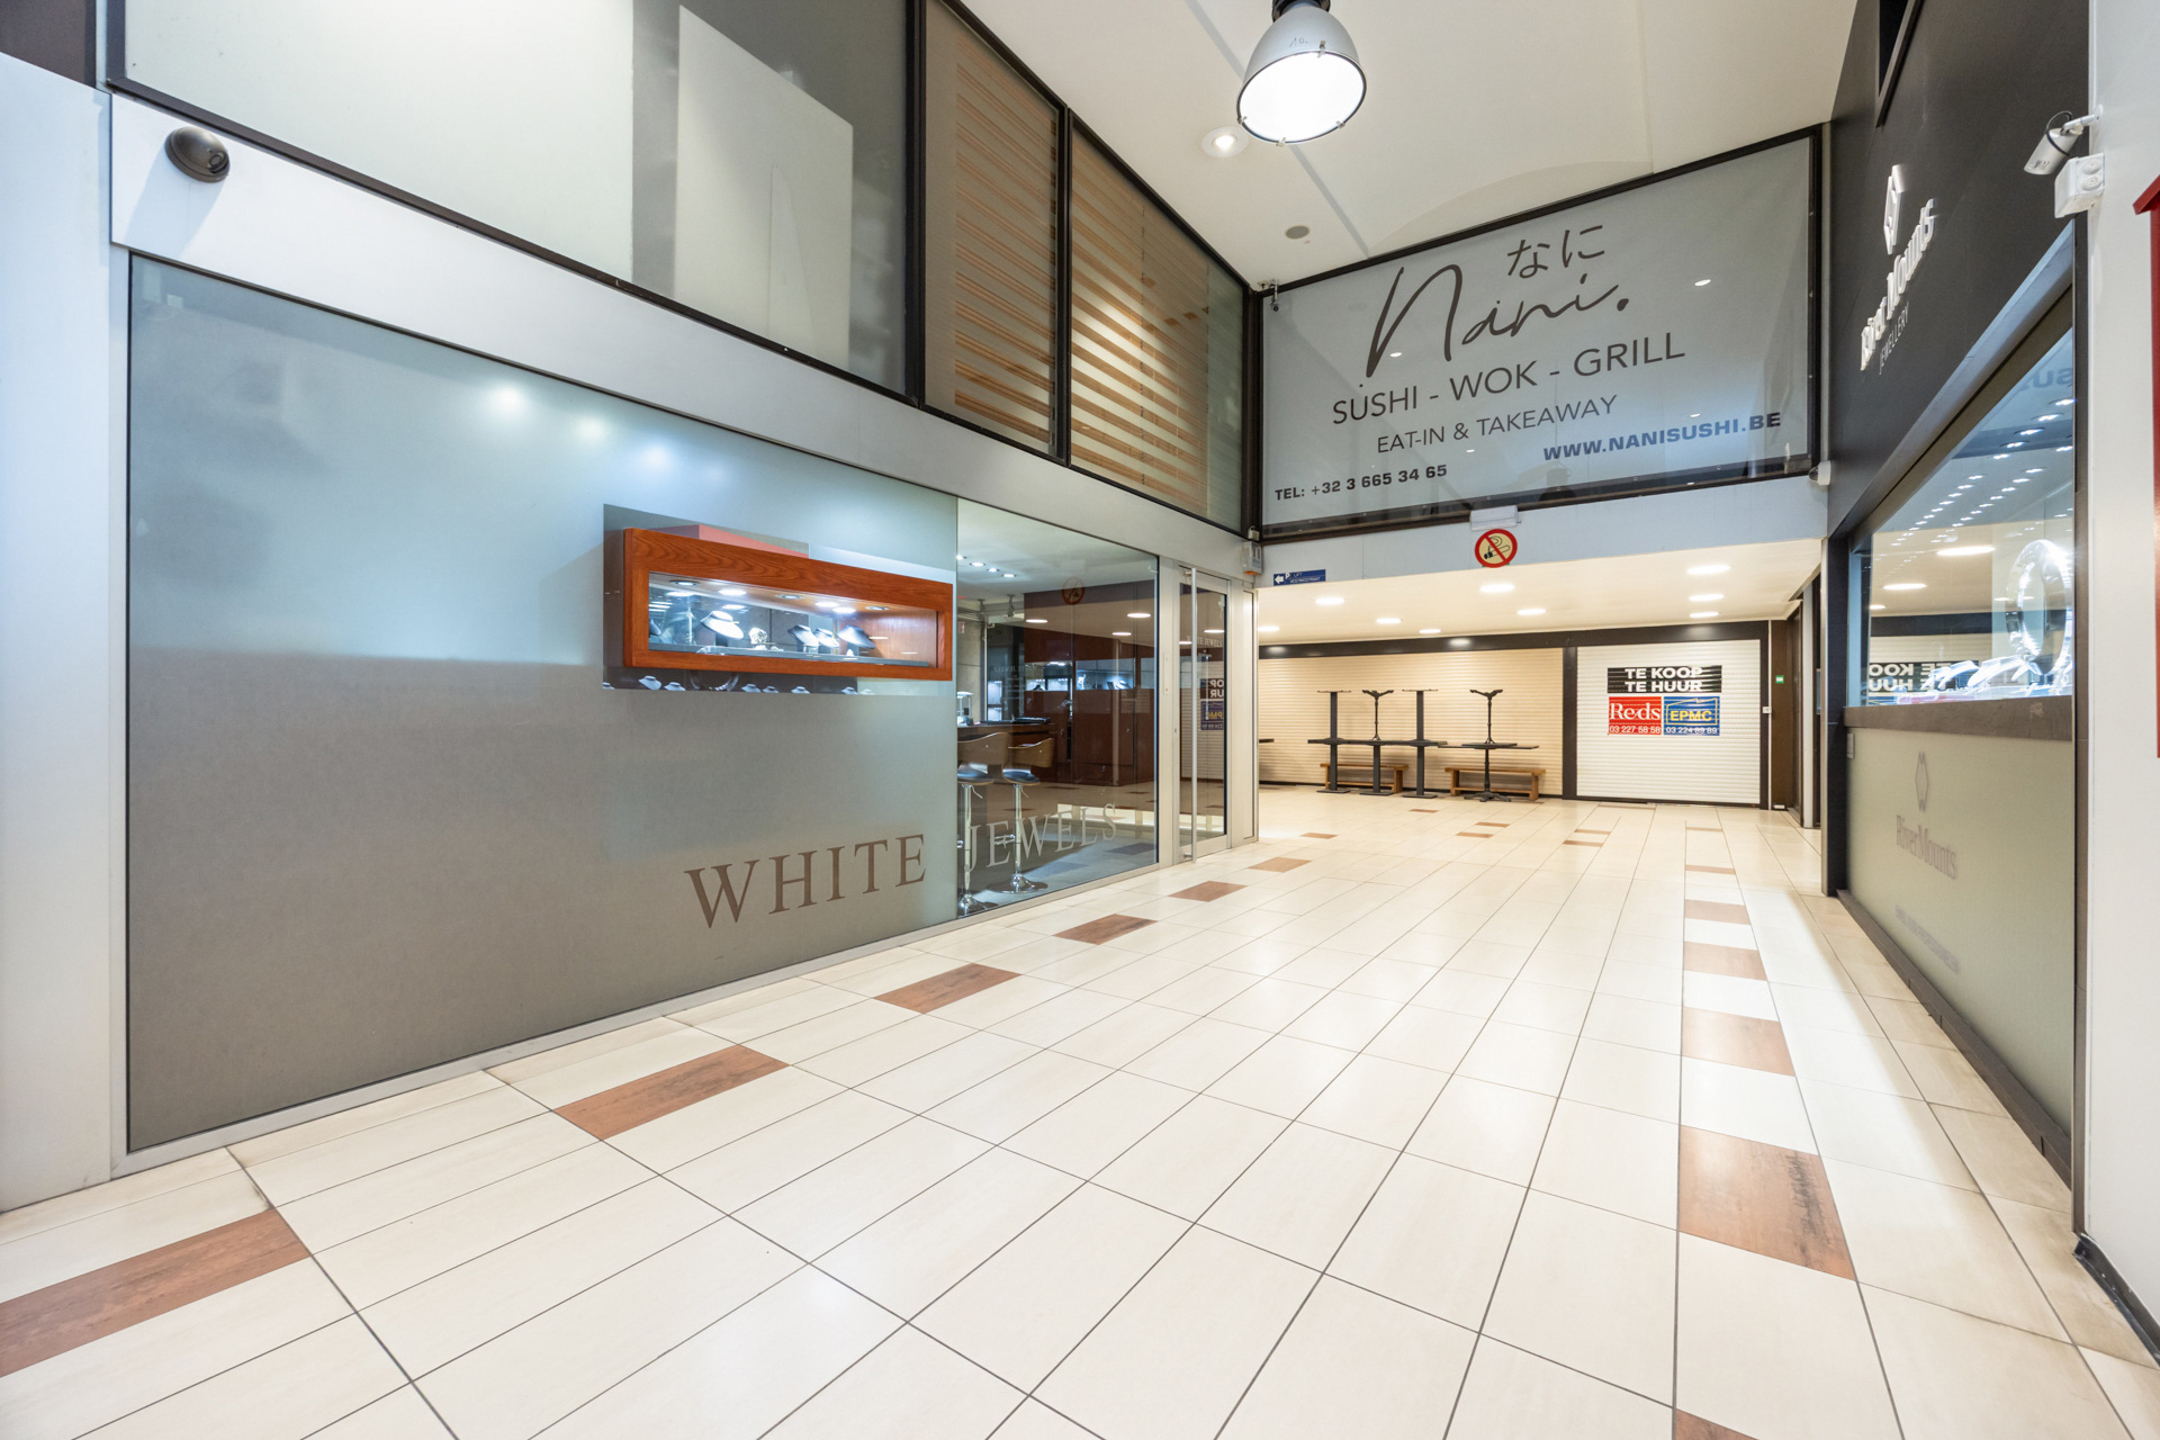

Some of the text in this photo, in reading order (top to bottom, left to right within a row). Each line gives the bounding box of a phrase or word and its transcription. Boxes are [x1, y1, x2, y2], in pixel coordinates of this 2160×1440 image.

[1506, 224, 1606, 280] なに
[1332, 385, 1417, 425] SUSHI
[1449, 360, 1539, 401] WOK
[1573, 332, 1686, 377] GRILL
[1377, 395, 1618, 453] EAT-IN & TAKEAWAY
[1543, 412, 1781, 461] WWW.NANISUSHI.BE
[1275, 464, 1448, 501] TEL: +32 3 665 34 65
[1625, 667, 1703, 679] TE KOOP
[1625, 681, 1703, 693] TE HUUR
[1609, 702, 1661, 720] Reds
[1649, 726, 1661, 734] 58
[1670, 710, 1712, 721] EPMC
[966, 802, 1118, 873] JEWELS
[683, 833, 927, 929] WHITE
